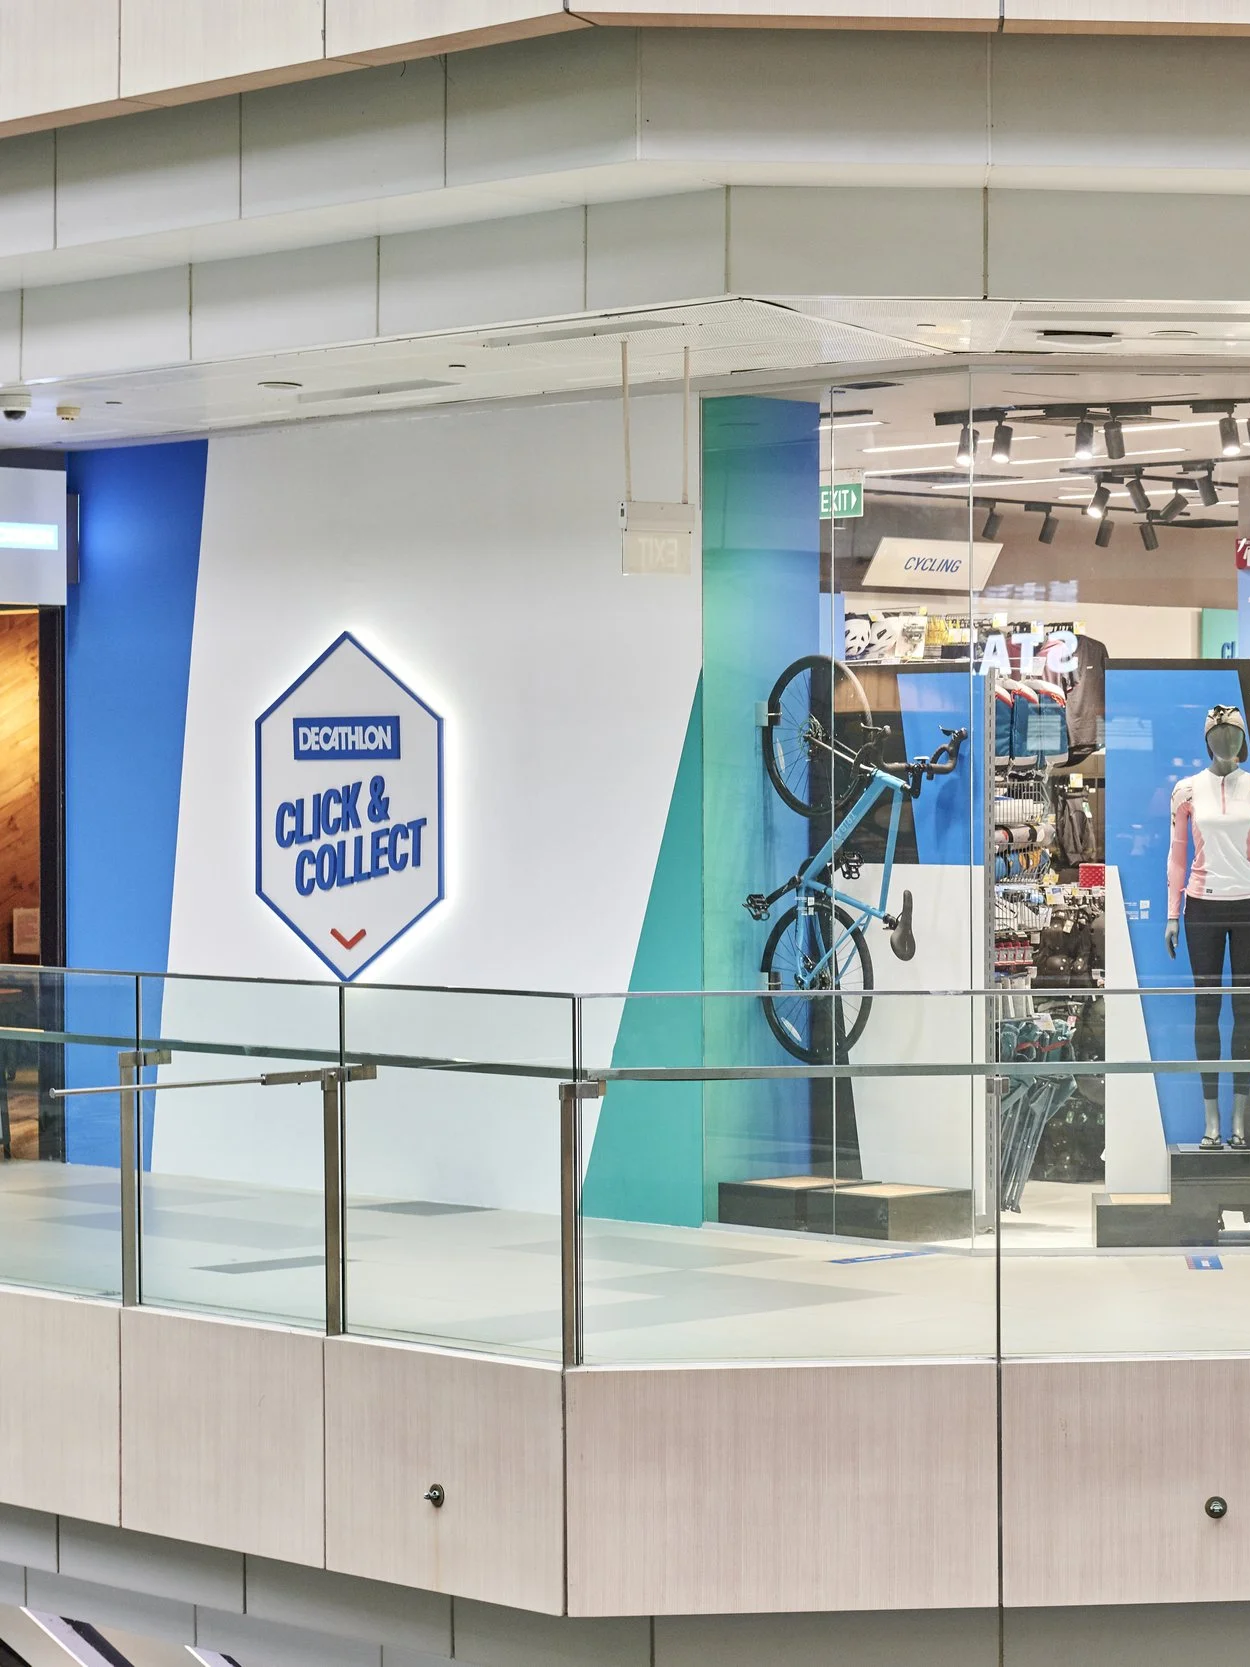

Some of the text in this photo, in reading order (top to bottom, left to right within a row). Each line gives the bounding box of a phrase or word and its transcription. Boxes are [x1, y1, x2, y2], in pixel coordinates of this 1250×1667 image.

[820, 489, 850, 513] EXIT
[904, 557, 962, 573] CYCLING
[299, 725, 392, 751] DECATHLON
[275, 775, 391, 848] CLICK &
[295, 817, 427, 896] COLLECT
